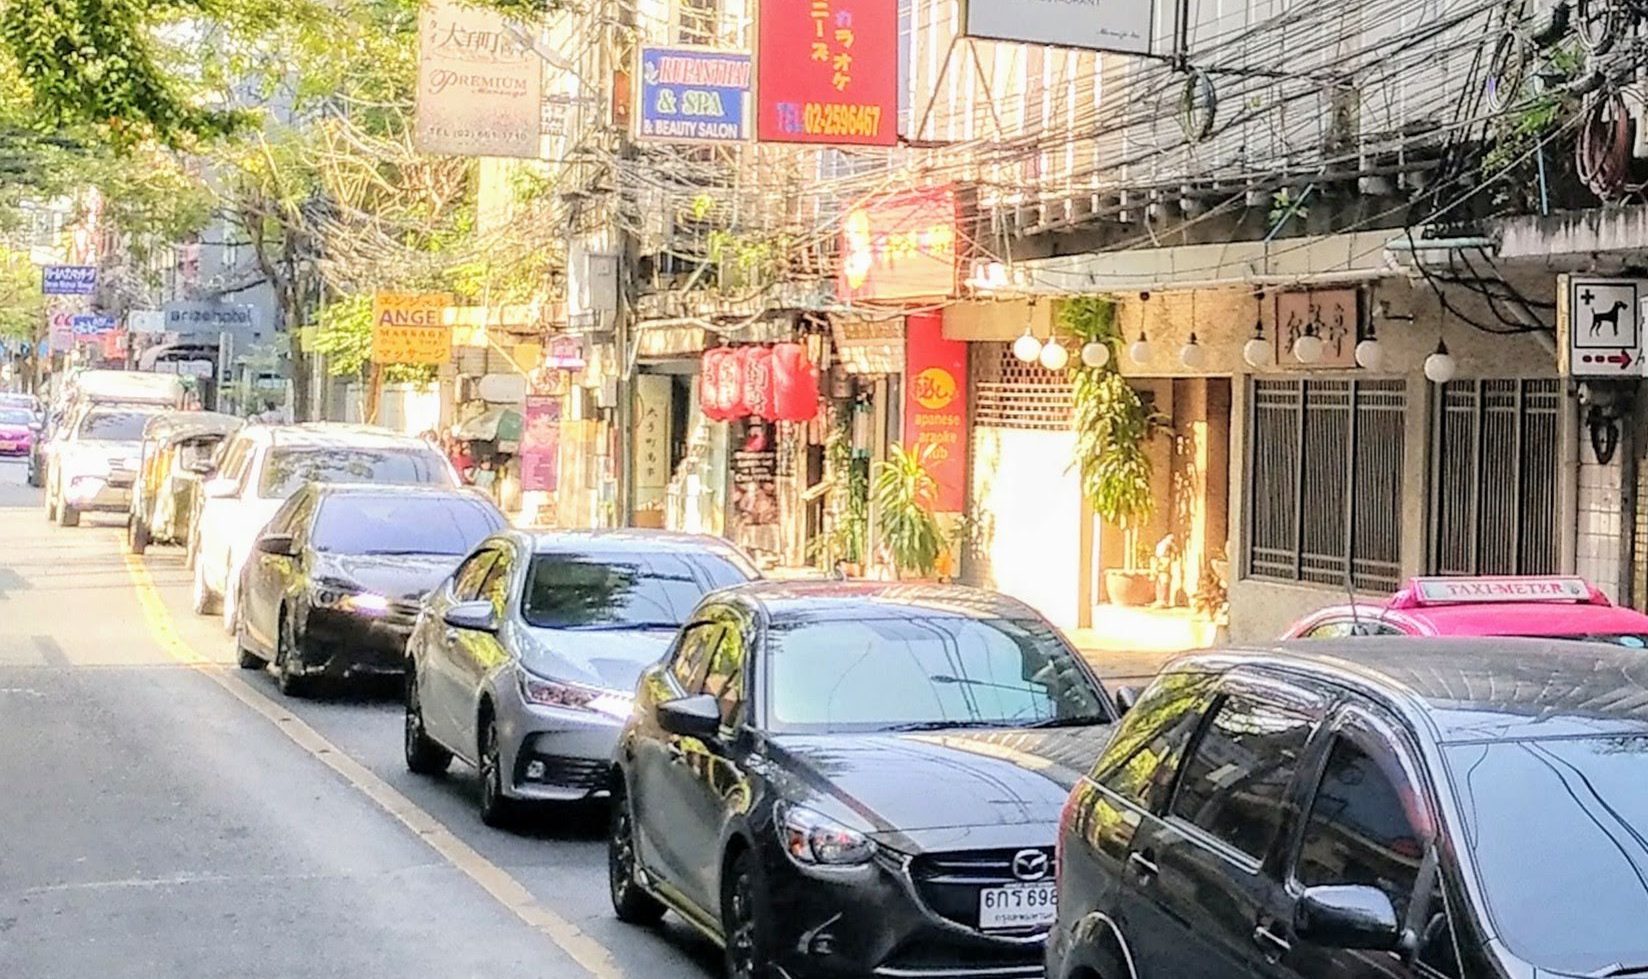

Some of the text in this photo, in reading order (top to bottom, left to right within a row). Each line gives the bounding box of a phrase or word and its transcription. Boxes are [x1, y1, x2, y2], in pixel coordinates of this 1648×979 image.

[658, 88, 724, 116] & SPA
[655, 119, 697, 136] BEAUTY
[698, 121, 738, 139] SALON
[1446, 582, 1565, 595] TAXI-METER
